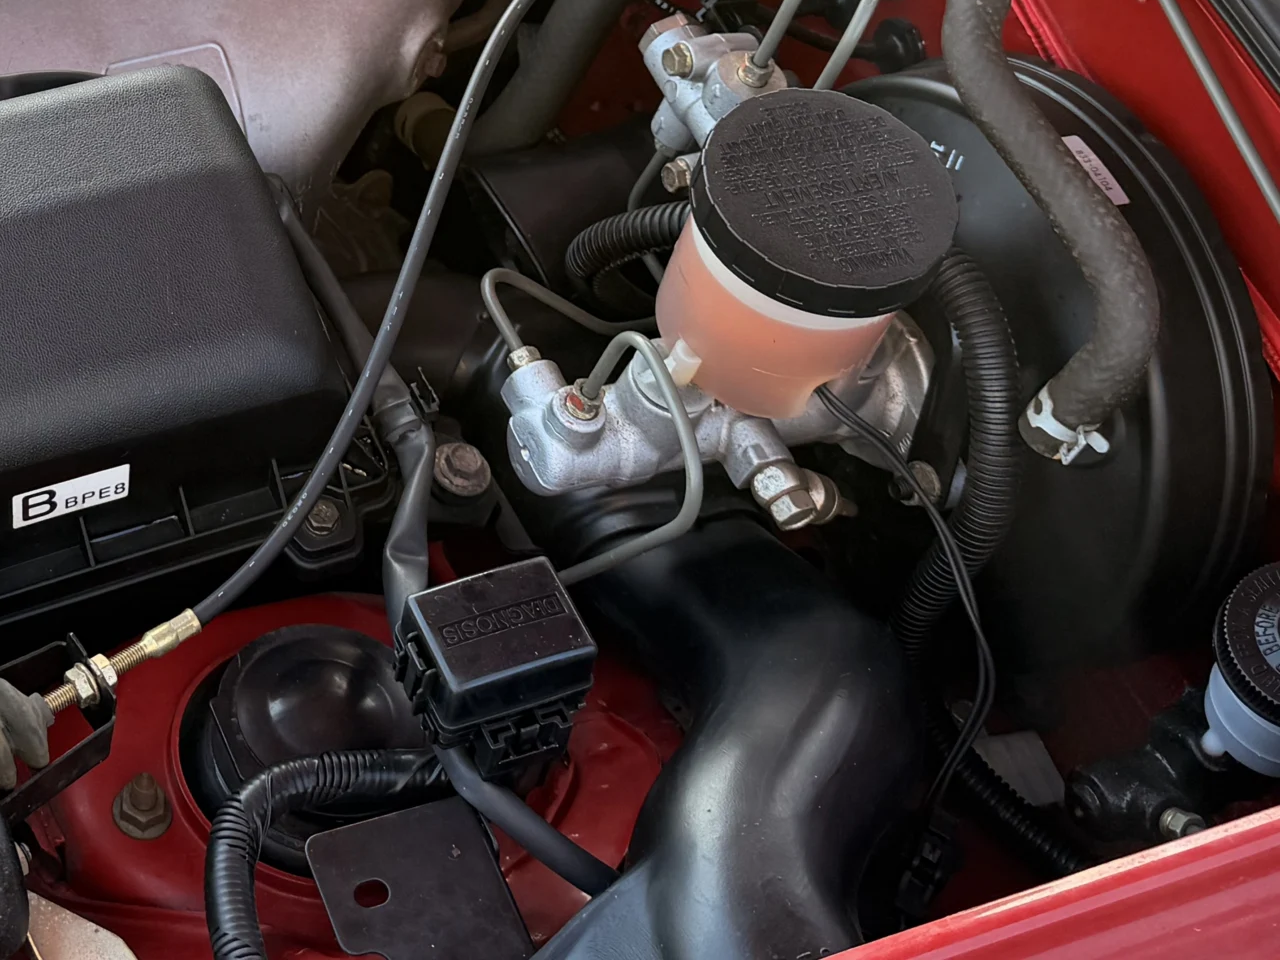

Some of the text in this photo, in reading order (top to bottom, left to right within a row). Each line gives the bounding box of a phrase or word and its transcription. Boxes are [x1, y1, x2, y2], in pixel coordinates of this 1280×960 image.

[763, 169, 902, 207] AVERTISSEMENT
[22, 482, 126, 521] B BPE8
[444, 597, 561, 645] DIAGNOSIS
